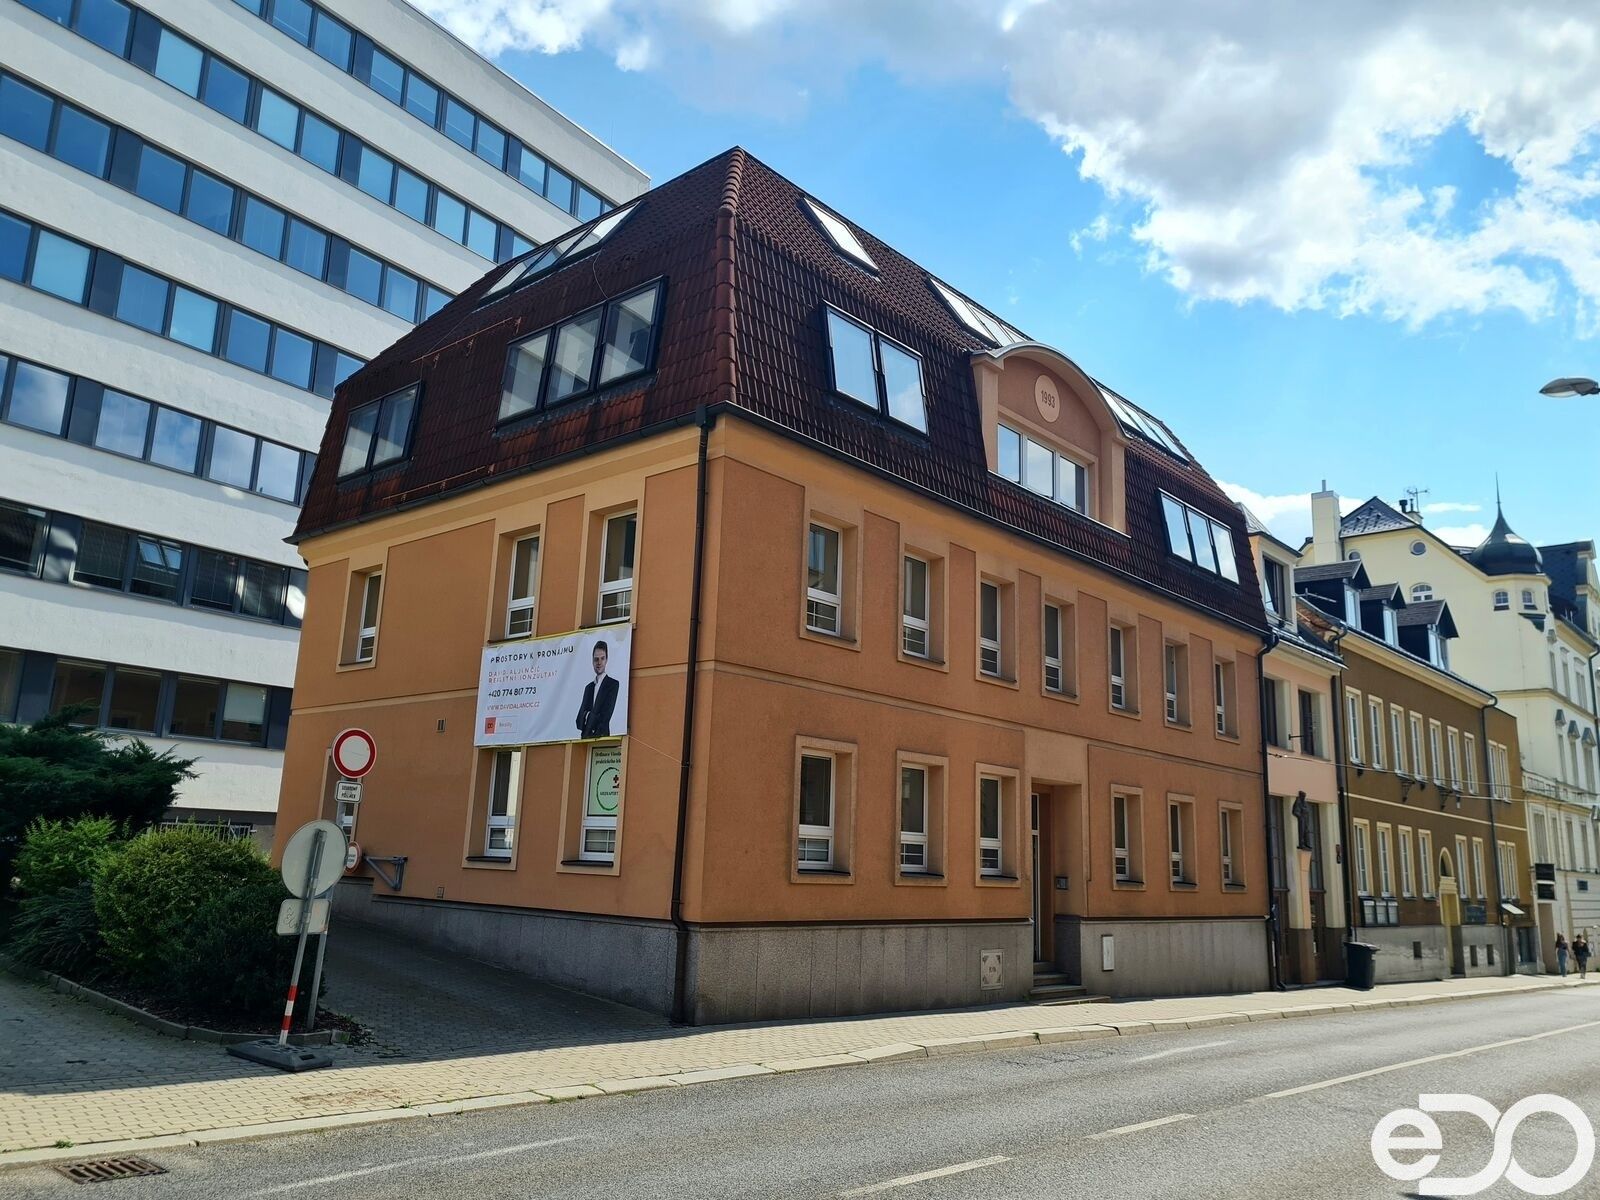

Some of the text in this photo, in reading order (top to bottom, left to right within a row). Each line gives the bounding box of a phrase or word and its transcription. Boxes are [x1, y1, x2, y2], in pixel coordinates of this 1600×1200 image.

[1041, 390, 1056, 409] 1993
[530, 652, 534, 660] K
[502, 688, 513, 697] 774
[525, 686, 537, 695] 773
